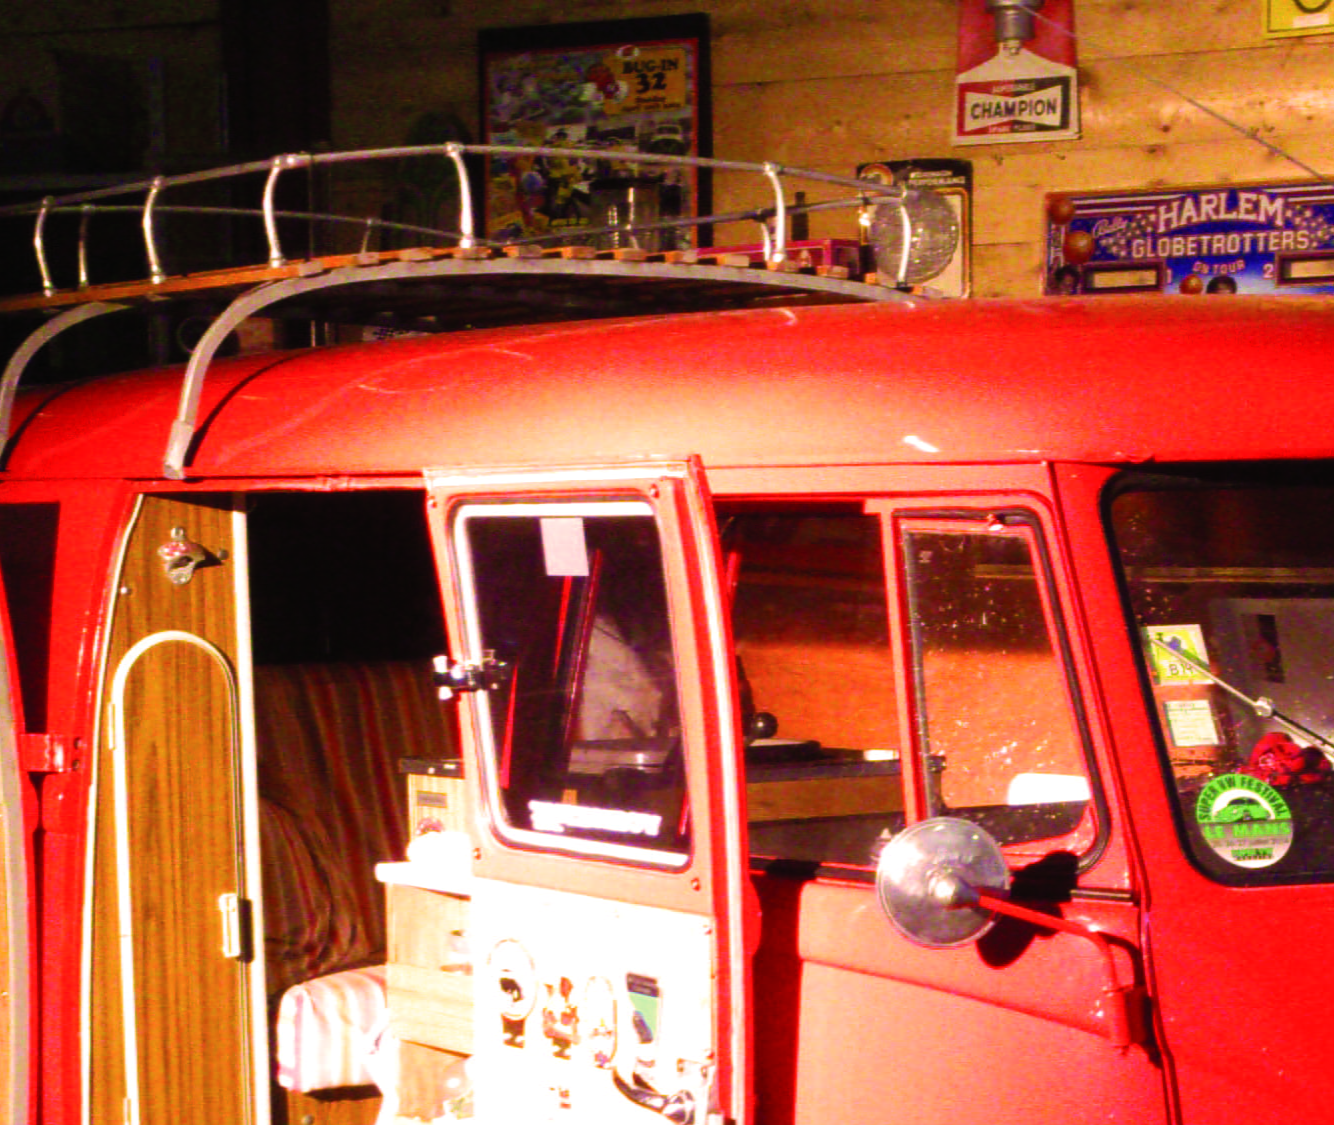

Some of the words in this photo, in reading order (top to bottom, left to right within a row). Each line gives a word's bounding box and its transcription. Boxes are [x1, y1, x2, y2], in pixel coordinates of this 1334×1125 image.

[622, 59, 679, 75] BUG-IN
[635, 72, 666, 94] 32
[970, 98, 1058, 120] CHAMPION
[1158, 192, 1285, 233] HARLEM
[1131, 229, 1310, 259] GLOBETROTTERS
[1213, 258, 1246, 275] TOUR
[1217, 776, 1237, 790] VW
[1240, 776, 1289, 818] FESTIVAL
[1202, 823, 1225, 840] LE
[1232, 820, 1293, 839] MANS
